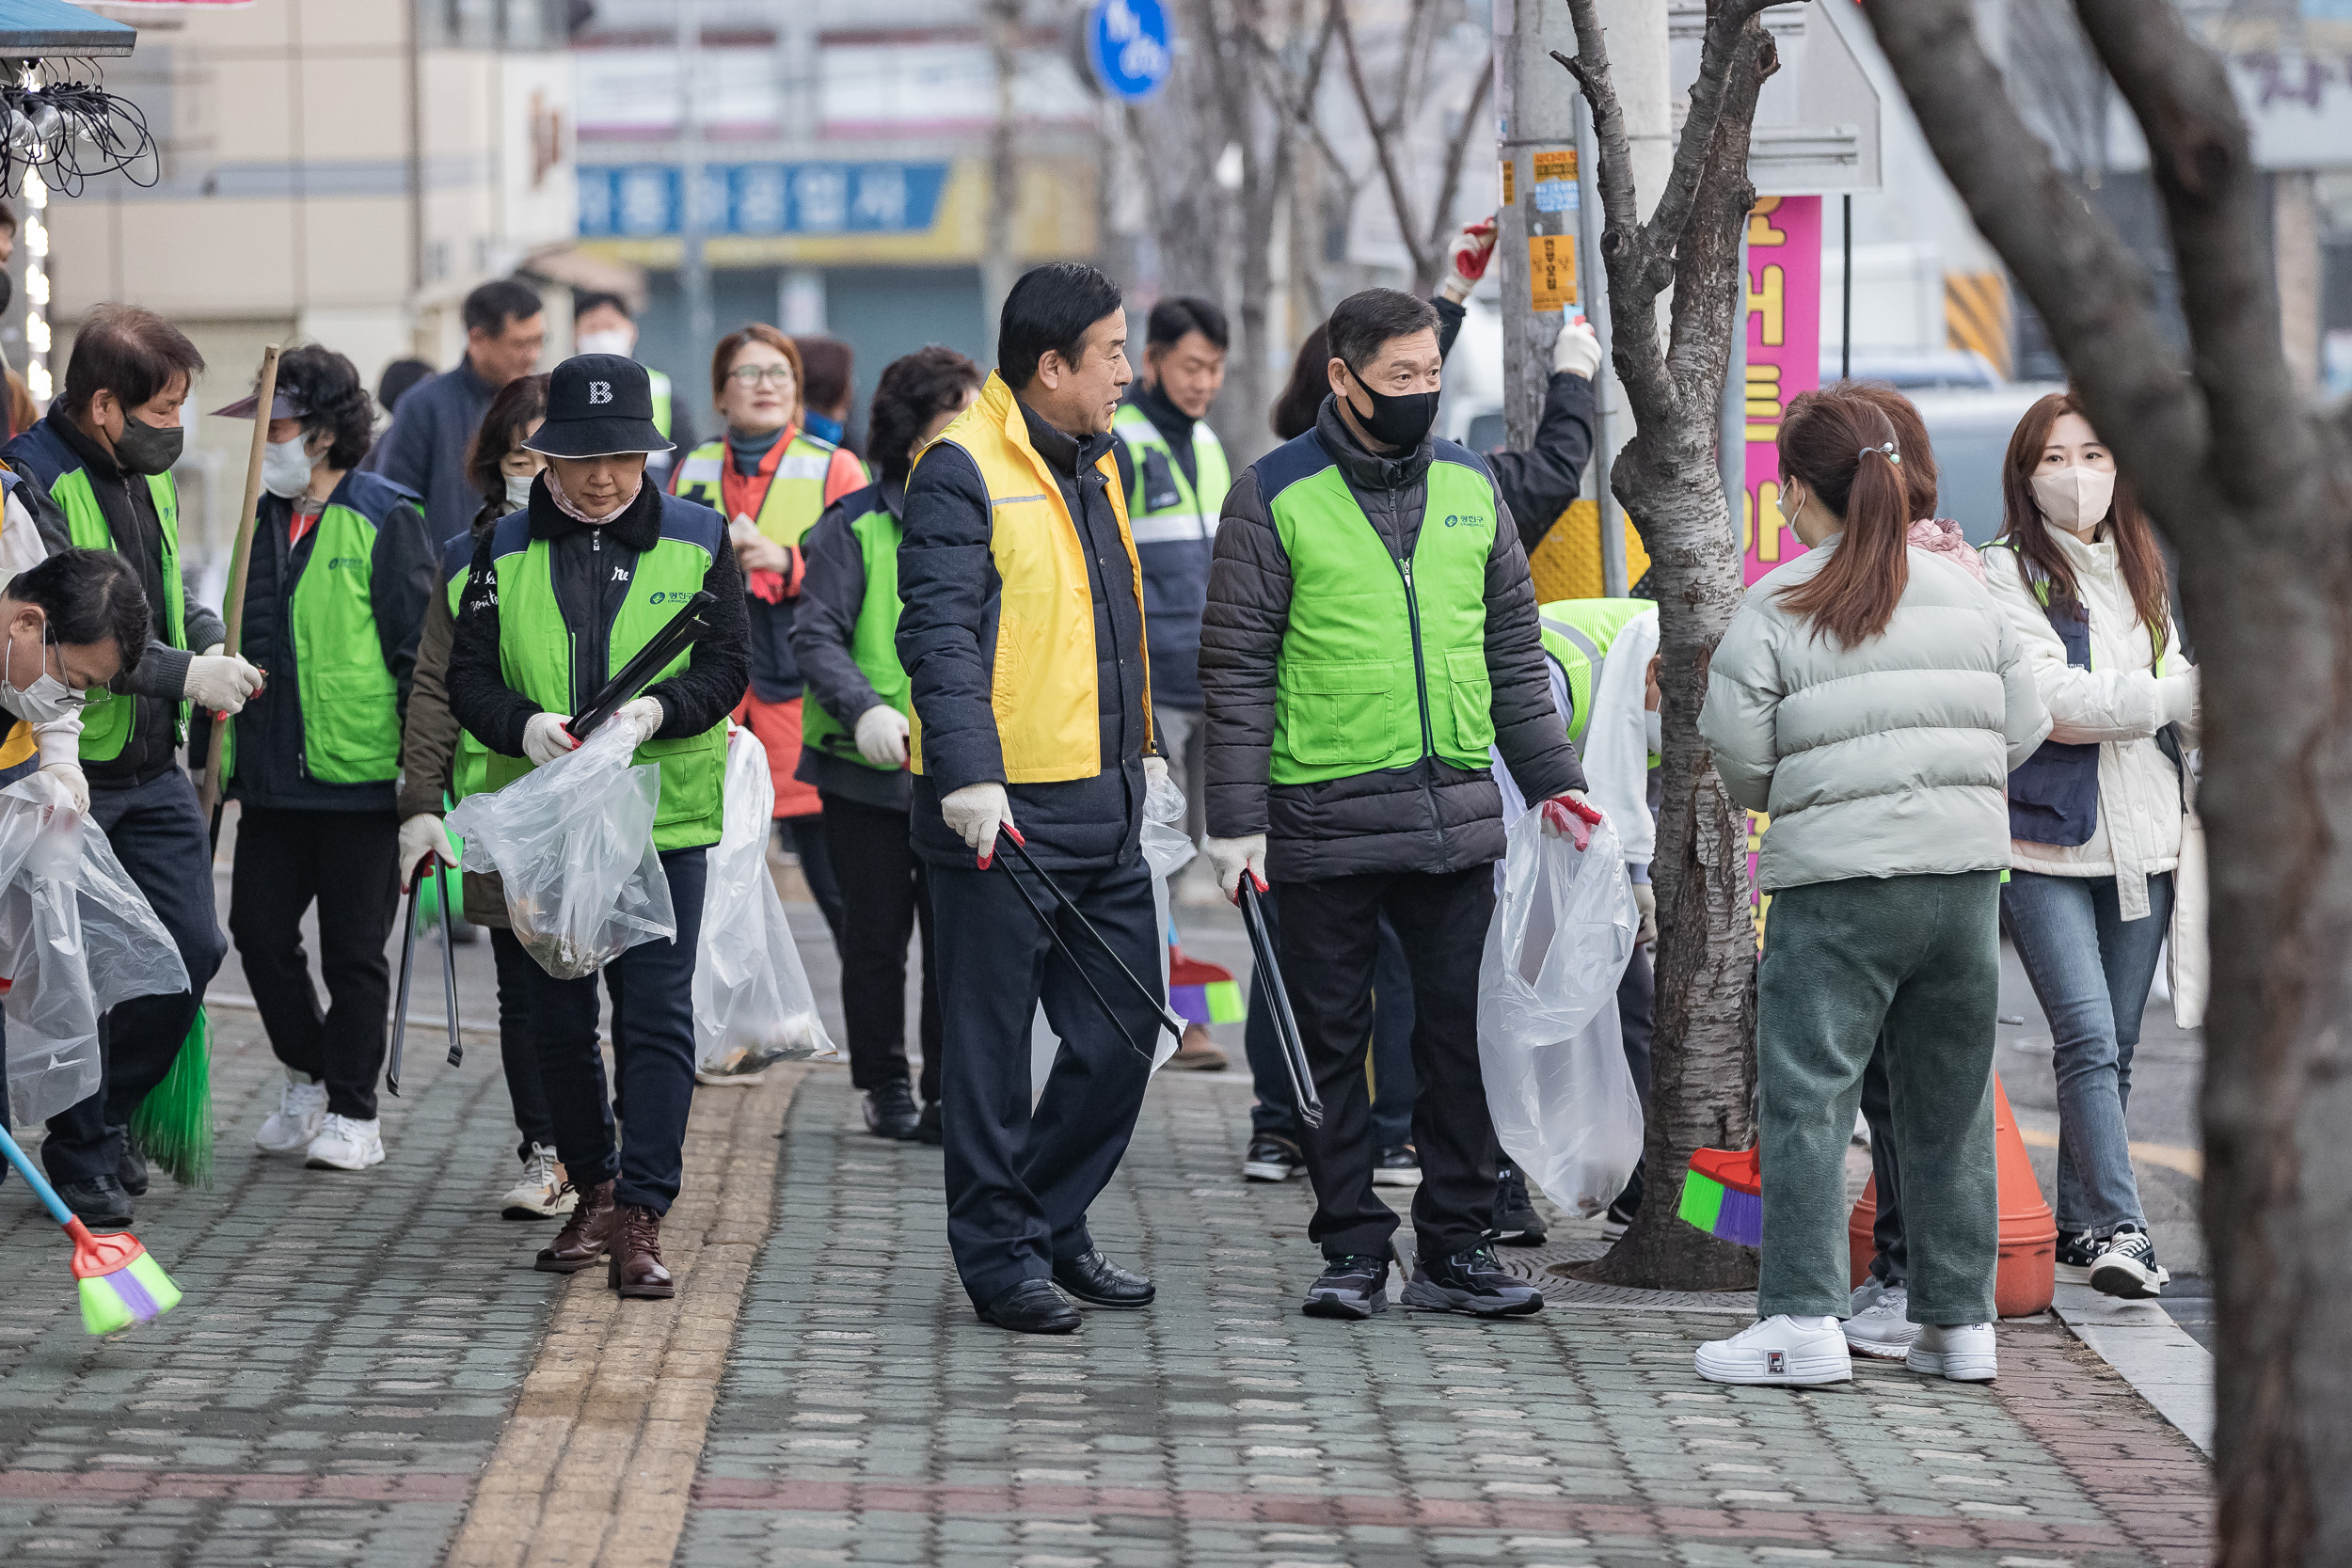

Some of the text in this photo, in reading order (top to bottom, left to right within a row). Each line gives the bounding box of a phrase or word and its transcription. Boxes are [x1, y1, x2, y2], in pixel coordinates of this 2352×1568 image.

[589, 381, 613, 404] B
[1459, 515, 1484, 524] 광진구
[668, 592, 694, 600] 광진구
